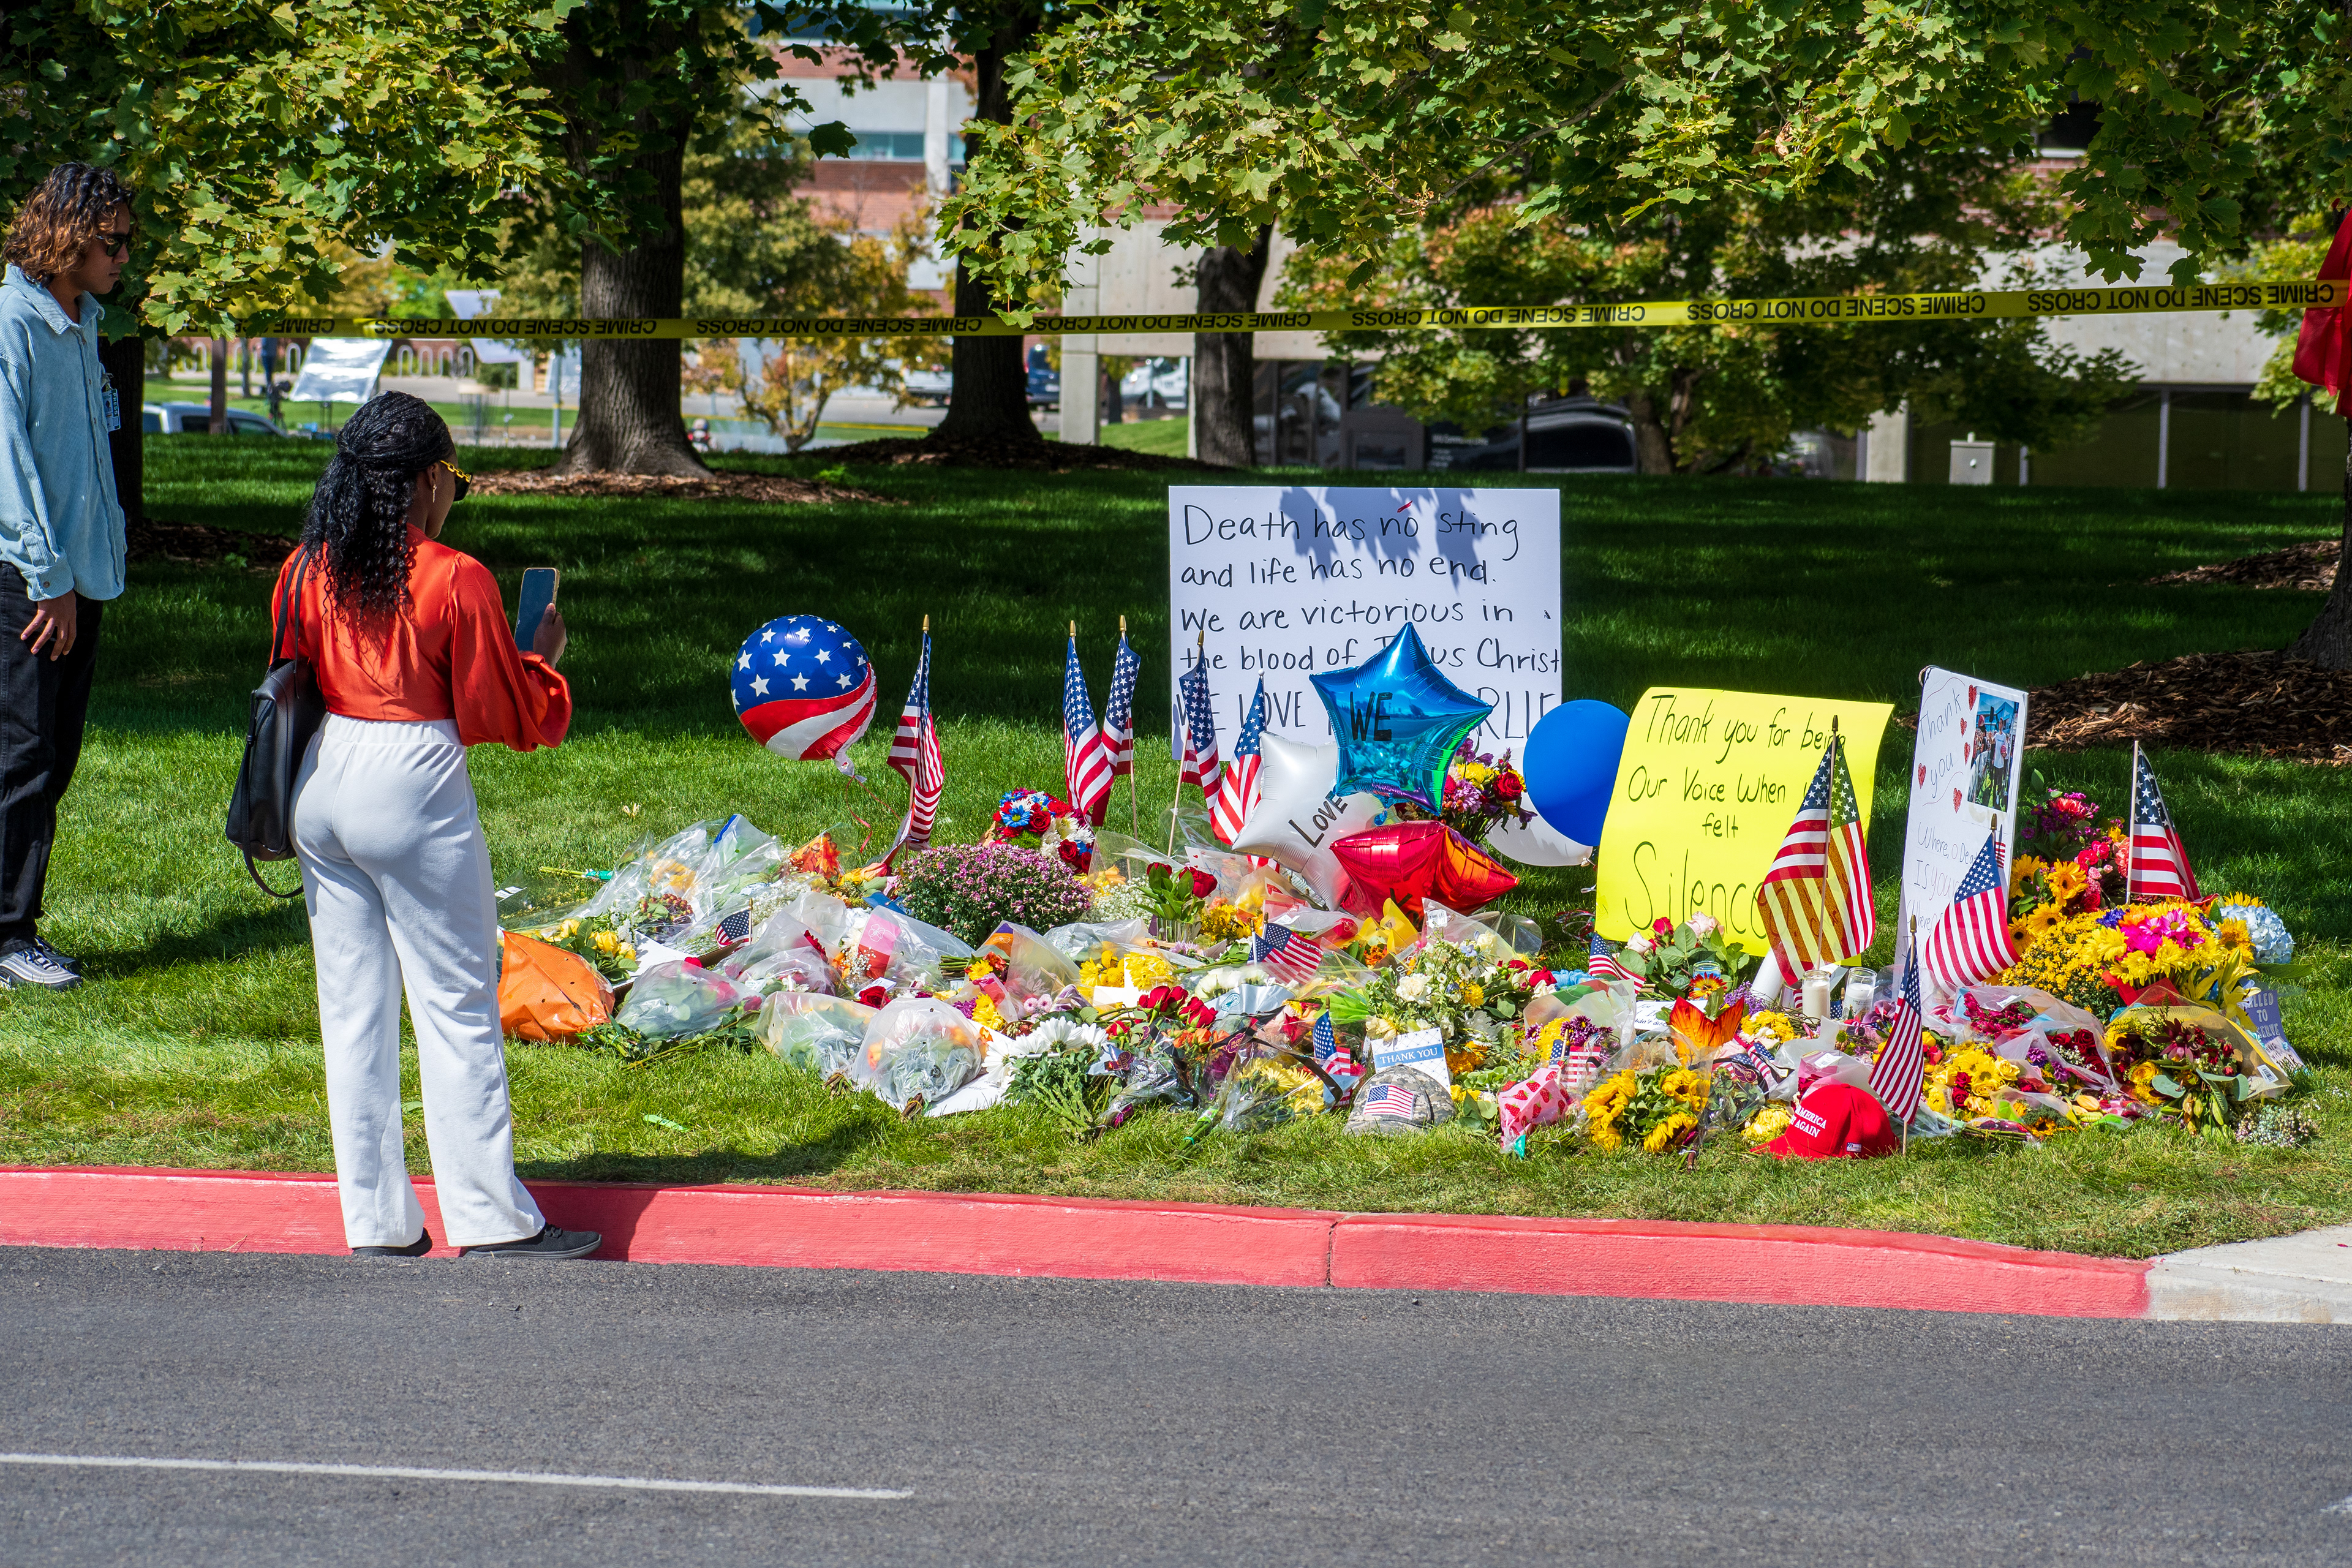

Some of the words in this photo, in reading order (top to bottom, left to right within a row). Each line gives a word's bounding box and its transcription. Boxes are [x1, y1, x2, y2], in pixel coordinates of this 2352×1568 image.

[2027, 292, 2101, 312] CROSS
[2106, 290, 2149, 310] NOT
[2154, 289, 2185, 307] DO
[2192, 285, 2262, 307] SCENE
[2267, 284, 2334, 305] CRIME
[1687, 303, 1758, 321] CROSS
[1763, 301, 1805, 319] NOT
[1811, 300, 1838, 318] DO
[1846, 297, 1915, 317] SCENE
[1920, 295, 1986, 315] CRIME
[1096, 316, 1137, 330] NOT
[1140, 315, 1171, 330] DO
[1176, 314, 1243, 330] SCENE
[1248, 313, 1311, 328] CRIME
[1351, 311, 1422, 326] CROSS
[1430, 309, 1469, 325] NOT
[1473, 309, 1503, 324] DO
[1508, 307, 1577, 324] SCENE
[1581, 306, 1645, 323] CRIME
[273, 319, 334, 333] CRIME
[375, 319, 441, 334] CROSS
[447, 320, 488, 334] NOT
[492, 320, 521, 334] DO
[525, 320, 590, 334] SCENE
[594, 320, 657, 334] CRIME
[696, 320, 764, 334] CROSS
[769, 320, 810, 334] NOT
[815, 320, 844, 334] DO
[848, 319, 915, 333] SCENE
[919, 318, 982, 333] CRIME
[1184, 504, 1300, 545] Death
[1314, 508, 1365, 541] has
[1380, 514, 1419, 538] no
[1438, 510, 1519, 561] sting
[1180, 563, 1233, 588] and
[1250, 556, 1297, 584] life
[1308, 555, 1363, 581] has
[1378, 556, 1415, 578] no
[1429, 556, 1497, 584] end.
[1238, 608, 1290, 631] are
[1300, 599, 1464, 626] victorious
[1481, 598, 1514, 623] in
[1240, 645, 1315, 671] blood
[1326, 638, 1359, 665] of
[1477, 637, 1560, 673] Christ
[1349, 692, 1393, 742] WE
[1919, 687, 1961, 746] Thank
[1646, 695, 1714, 745] Thank
[1716, 718, 1758, 764] you
[1768, 707, 1790, 748] for
[1628, 765, 1667, 802] Our
[1684, 766, 1725, 802] Voice
[1930, 752, 1954, 799] you
[1287, 790, 1349, 848] LOVE
[1702, 812, 1739, 839] felt
[2256, 1008, 2268, 1023] TO
[2257, 1022, 2280, 1039] SERVE
[1379, 1052, 1415, 1064] THANK
[1418, 1047, 1438, 1058] YOU
[1795, 1104, 1827, 1129] AMERICA
[1794, 1119, 1821, 1138] AGAIN
